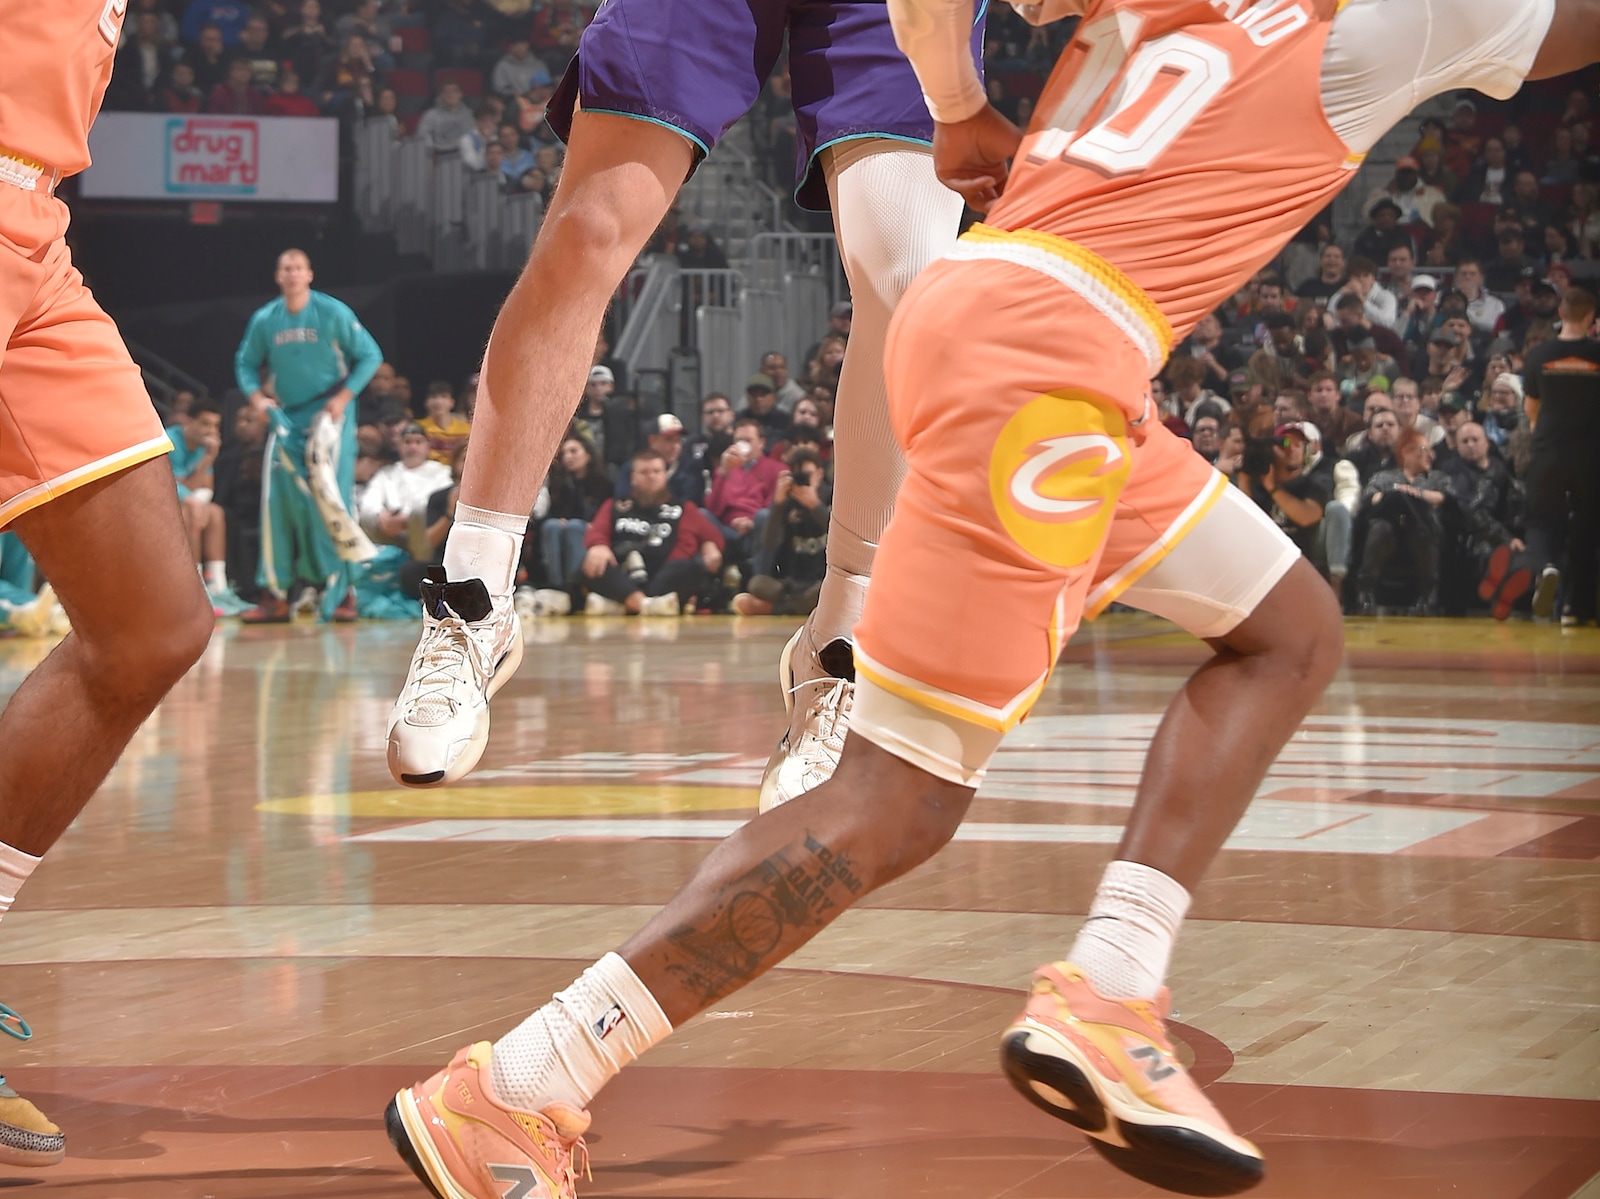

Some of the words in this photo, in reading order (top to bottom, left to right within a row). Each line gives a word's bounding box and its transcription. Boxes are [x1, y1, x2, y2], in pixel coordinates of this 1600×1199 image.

[1024, 4, 1234, 179] 10
[173, 121, 243, 162] drug
[178, 161, 258, 185] mart
[455, 1080, 475, 1106] TEN
